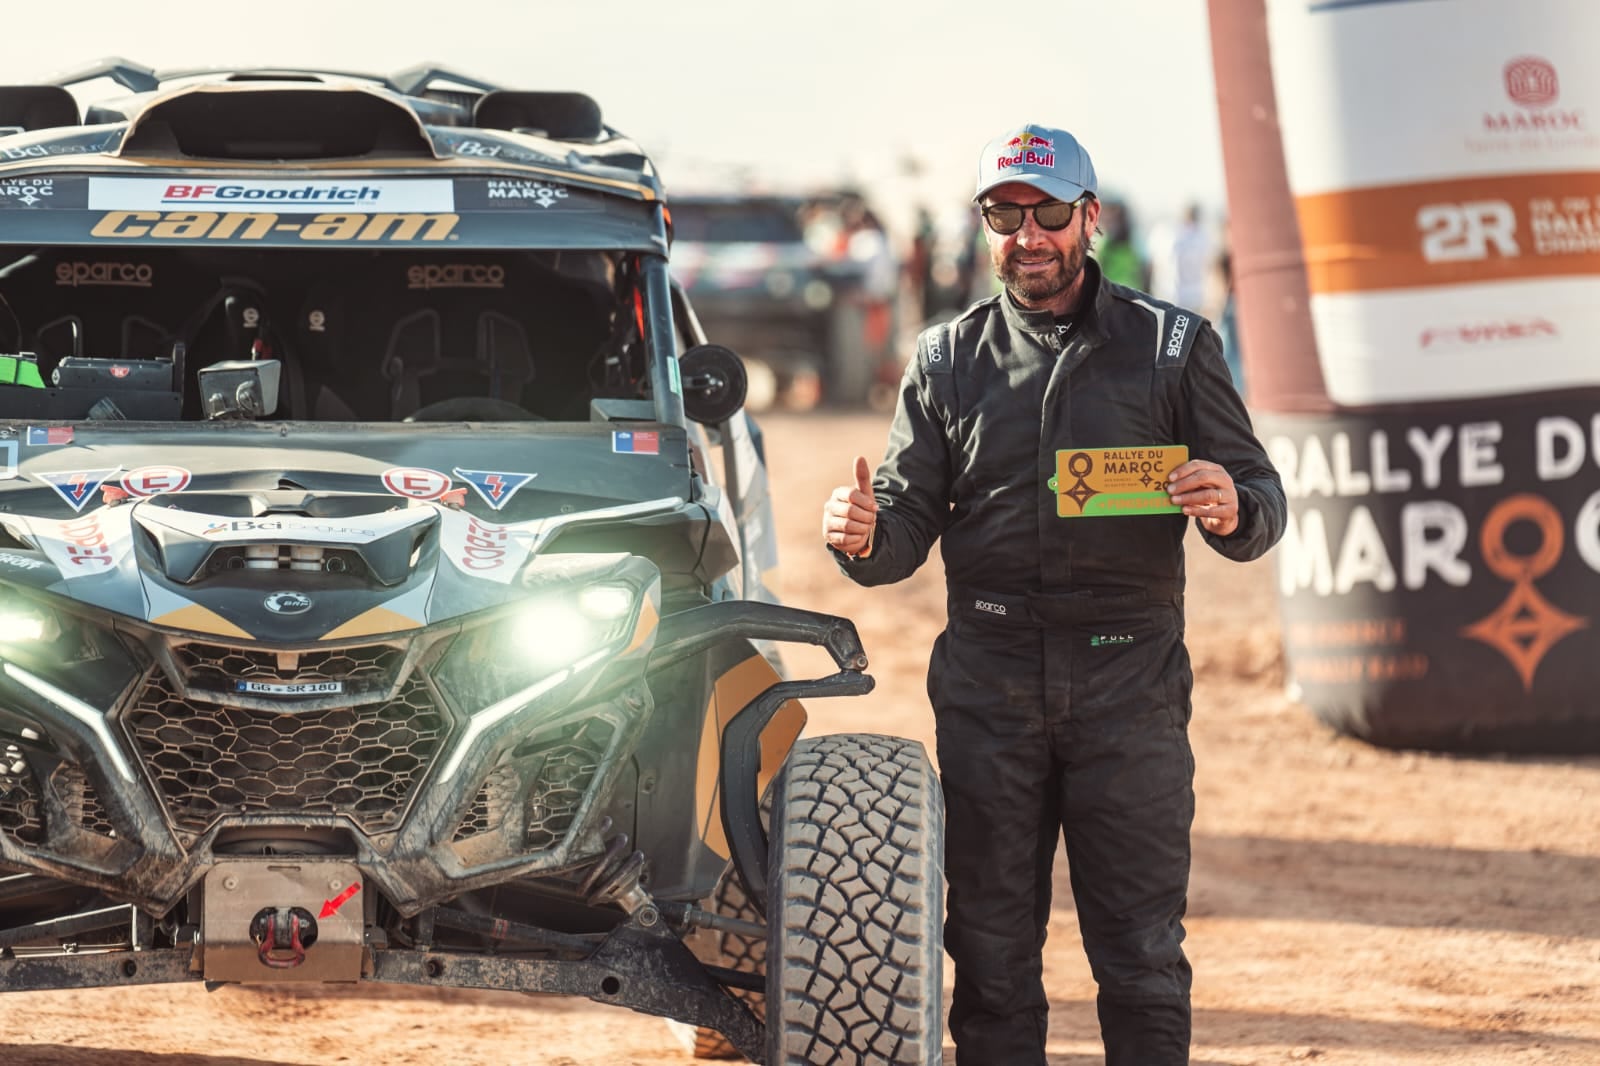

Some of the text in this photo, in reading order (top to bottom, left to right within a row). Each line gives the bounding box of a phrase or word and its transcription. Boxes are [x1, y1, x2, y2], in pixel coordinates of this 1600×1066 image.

[998, 151, 1055, 170] Red Bull
[163, 184, 381, 200] BFGoodrich
[488, 180, 542, 188] RALLYE
[488, 188, 569, 199] MAROC
[90, 211, 460, 241] can-am
[1416, 199, 1520, 263] 2R
[56, 261, 152, 287] sparco
[408, 263, 504, 289] sparco
[1167, 314, 1190, 358] sparco
[1104, 450, 1163, 460] RALLYE DU
[1268, 421, 1504, 497] RALLYE
[1104, 461, 1164, 474] MAROC
[232, 521, 282, 531] Bci
[462, 517, 508, 570] COPEC
[975, 600, 1006, 614] sparco
